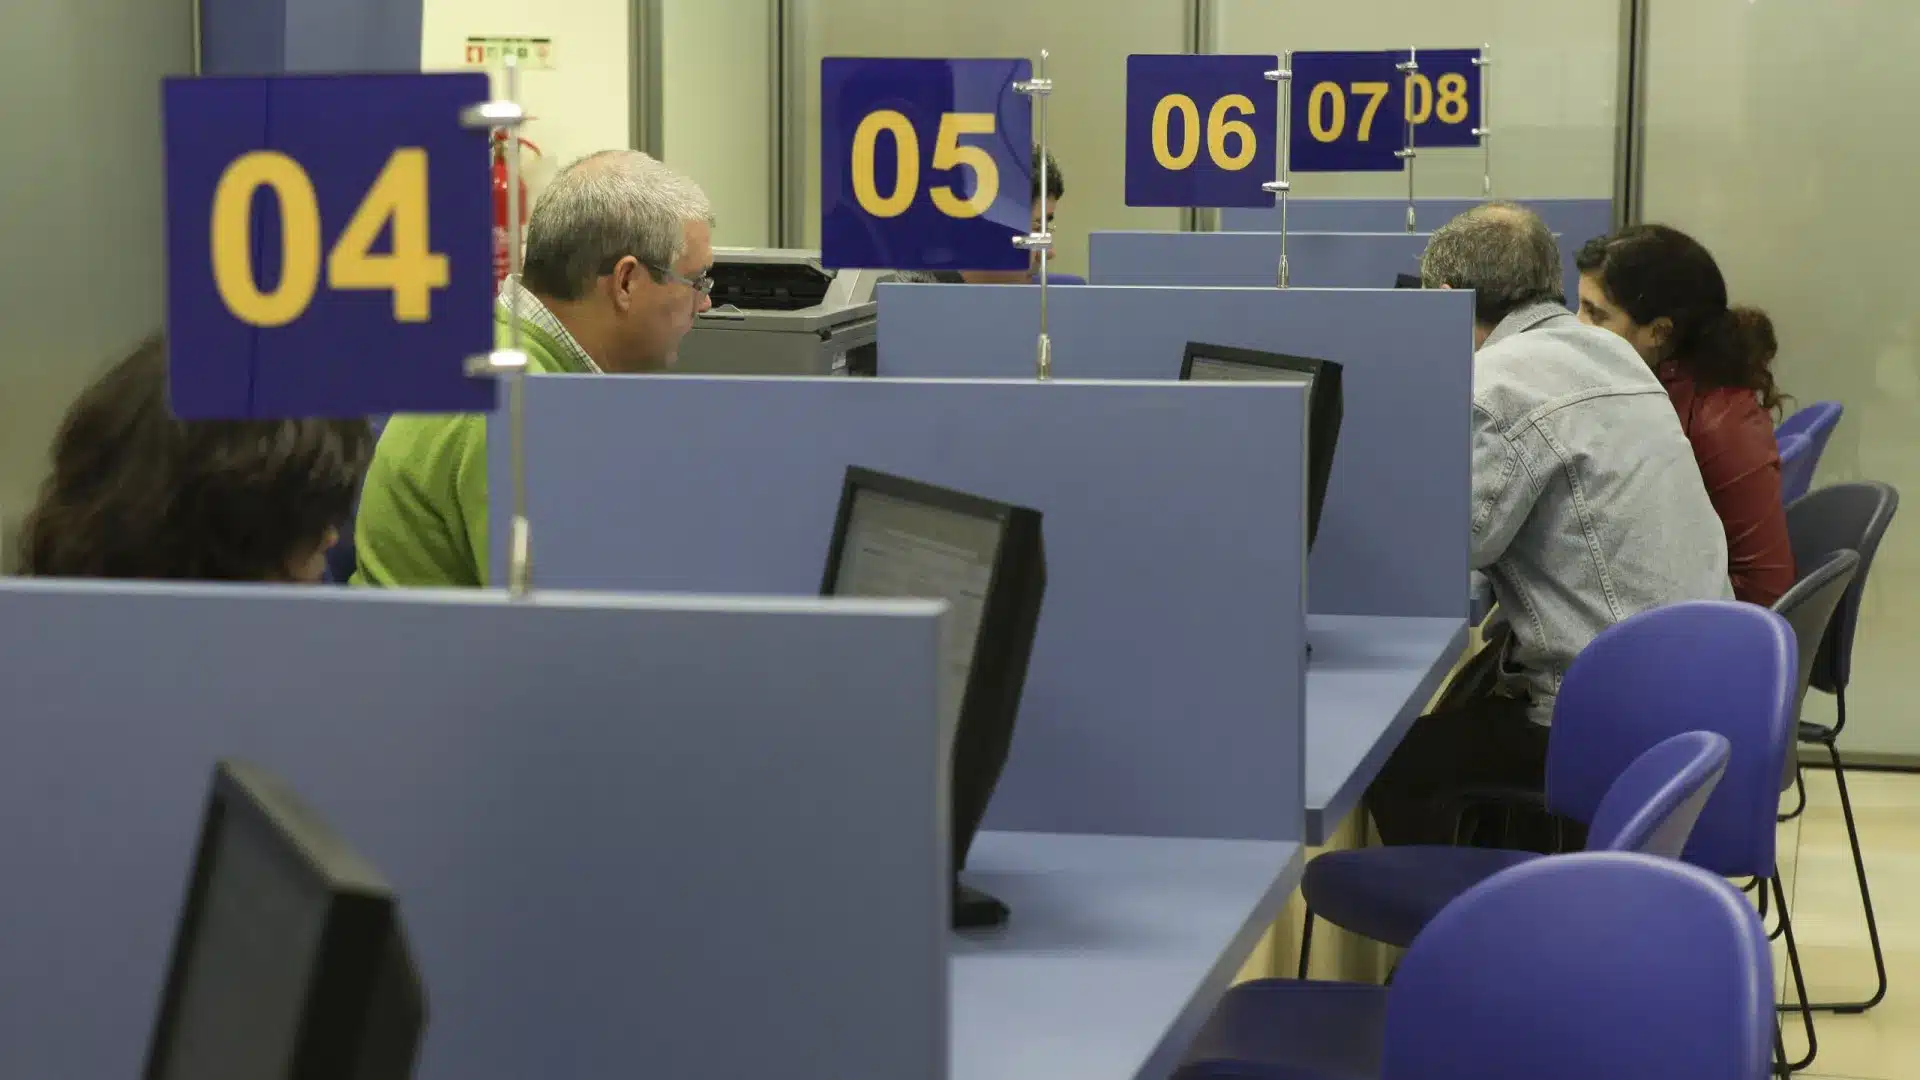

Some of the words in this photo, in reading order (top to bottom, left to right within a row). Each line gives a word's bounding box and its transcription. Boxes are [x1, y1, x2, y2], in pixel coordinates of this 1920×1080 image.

[1151, 93, 1257, 171] 06
[1307, 81, 1389, 143] 07
[1404, 72, 1469, 124] 08
[851, 109, 999, 219] 05
[210, 147, 451, 327] 04
